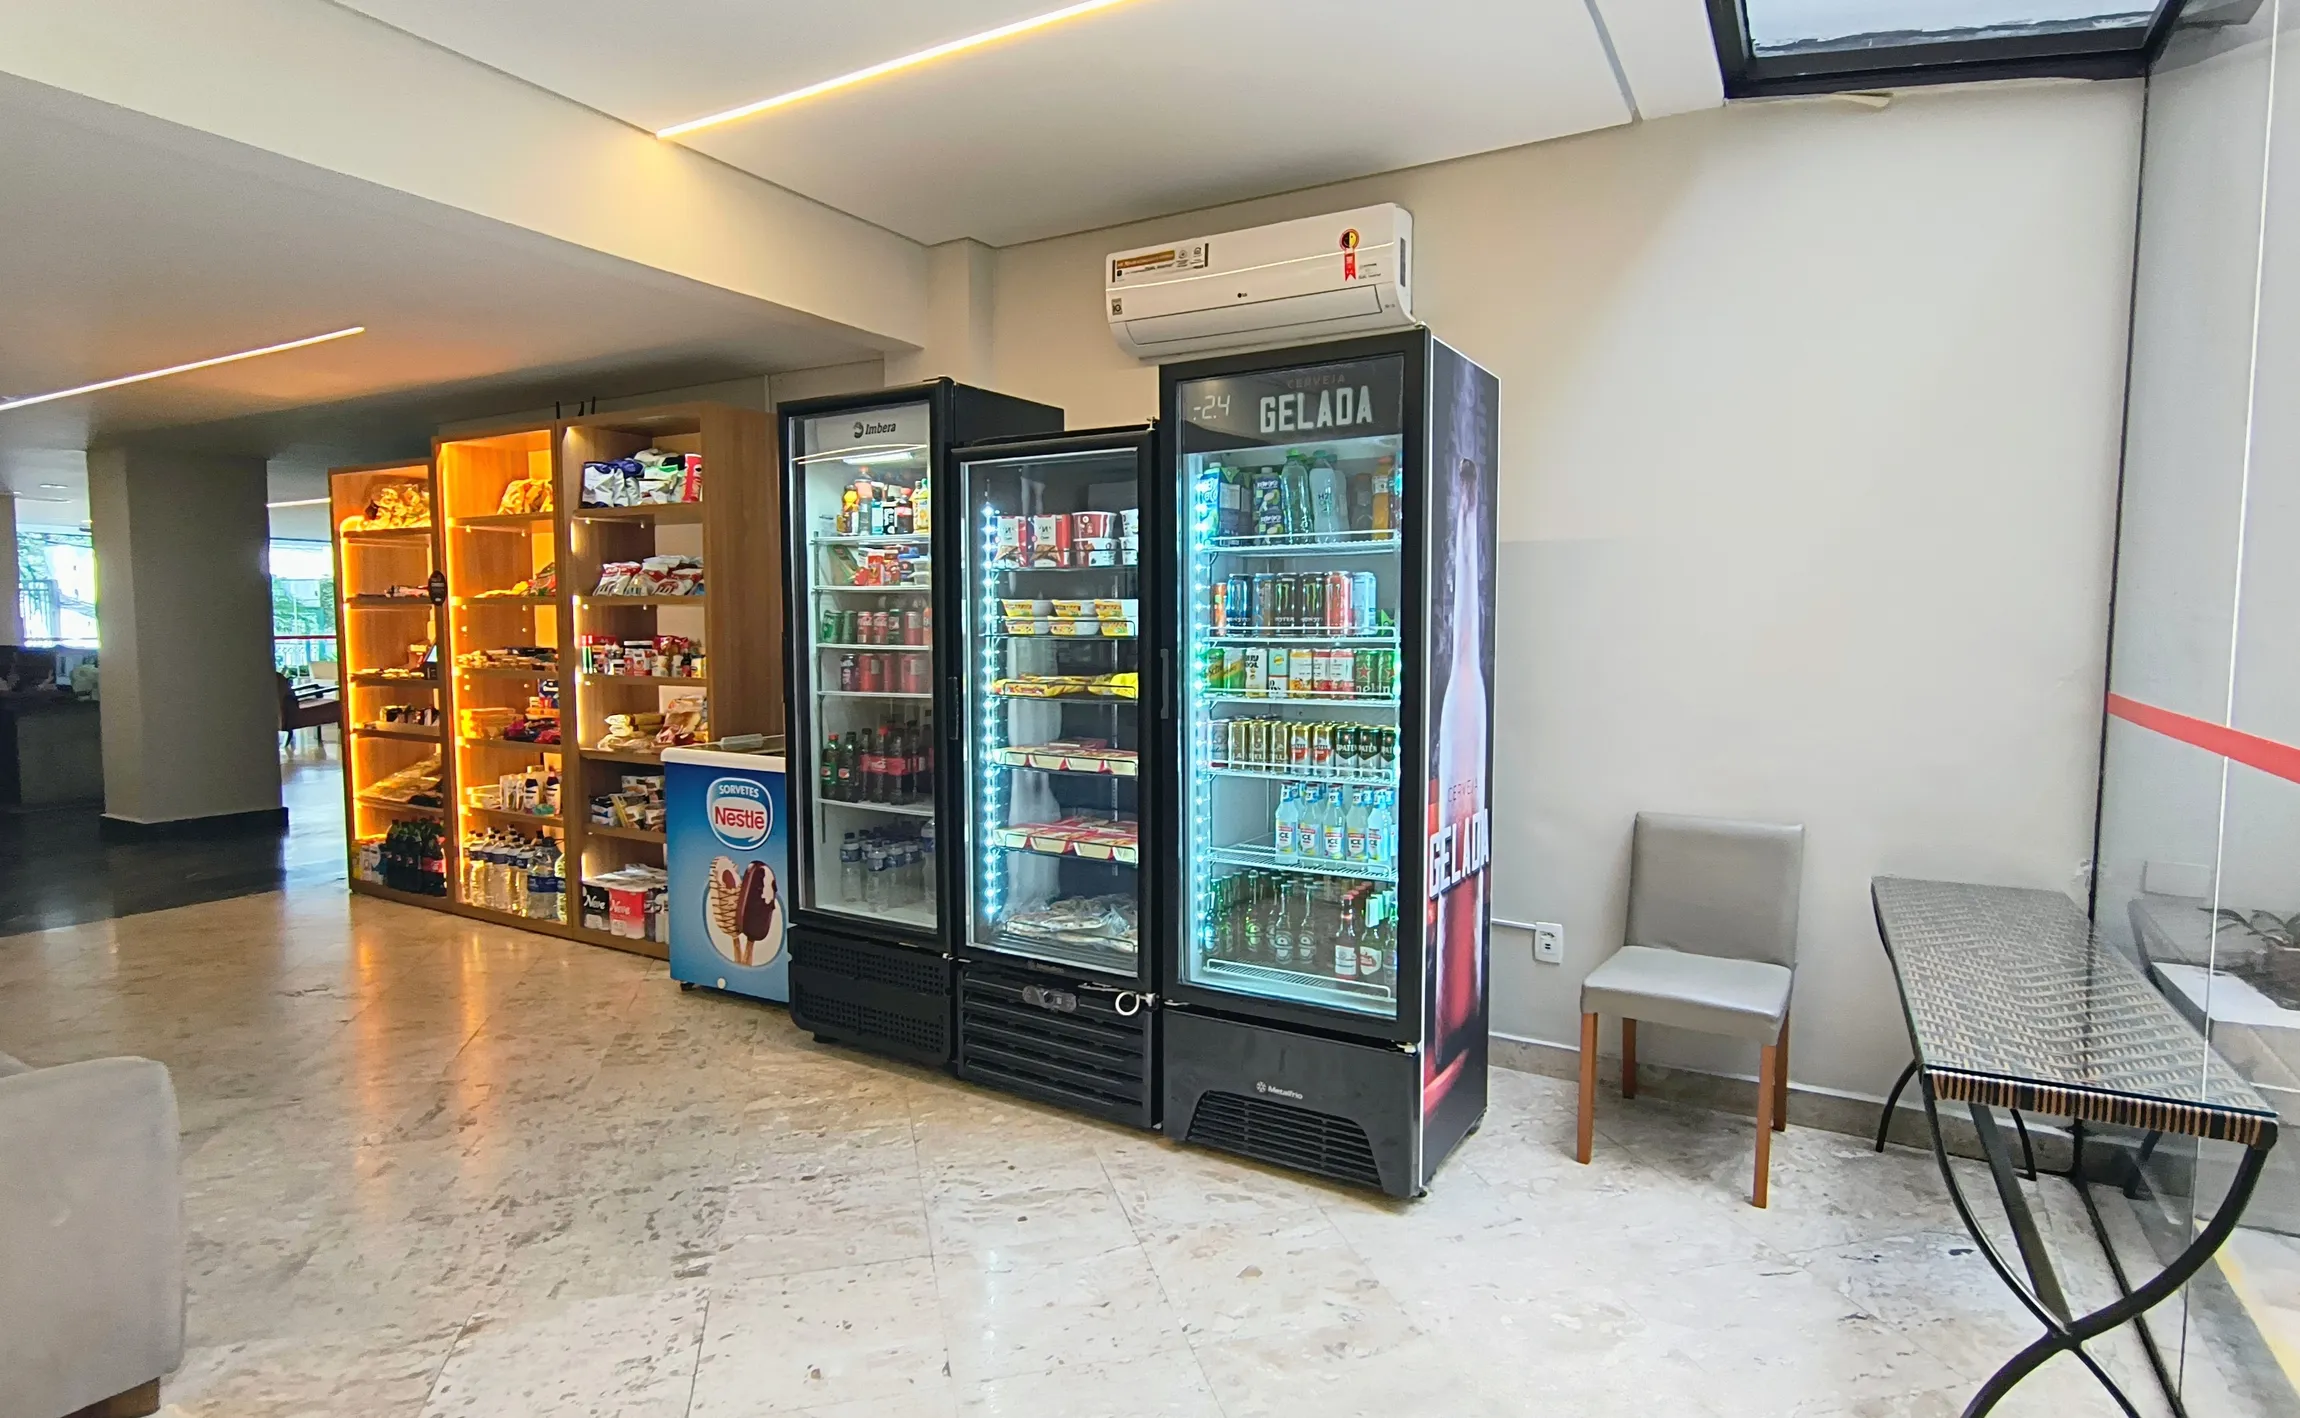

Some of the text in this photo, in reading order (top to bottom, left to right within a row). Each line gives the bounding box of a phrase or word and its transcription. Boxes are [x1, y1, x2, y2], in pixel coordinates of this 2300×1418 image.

[1287, 373, 1346, 389] CERVEJA
[1259, 385, 1373, 434] GELADA
[865, 422, 896, 435] Imbera
[718, 784, 760, 799] SORVETES
[714, 805, 765, 830] Nestlé
[1429, 807, 1490, 900] GELADA
[1267, 1085, 1303, 1099] Metalfrio
